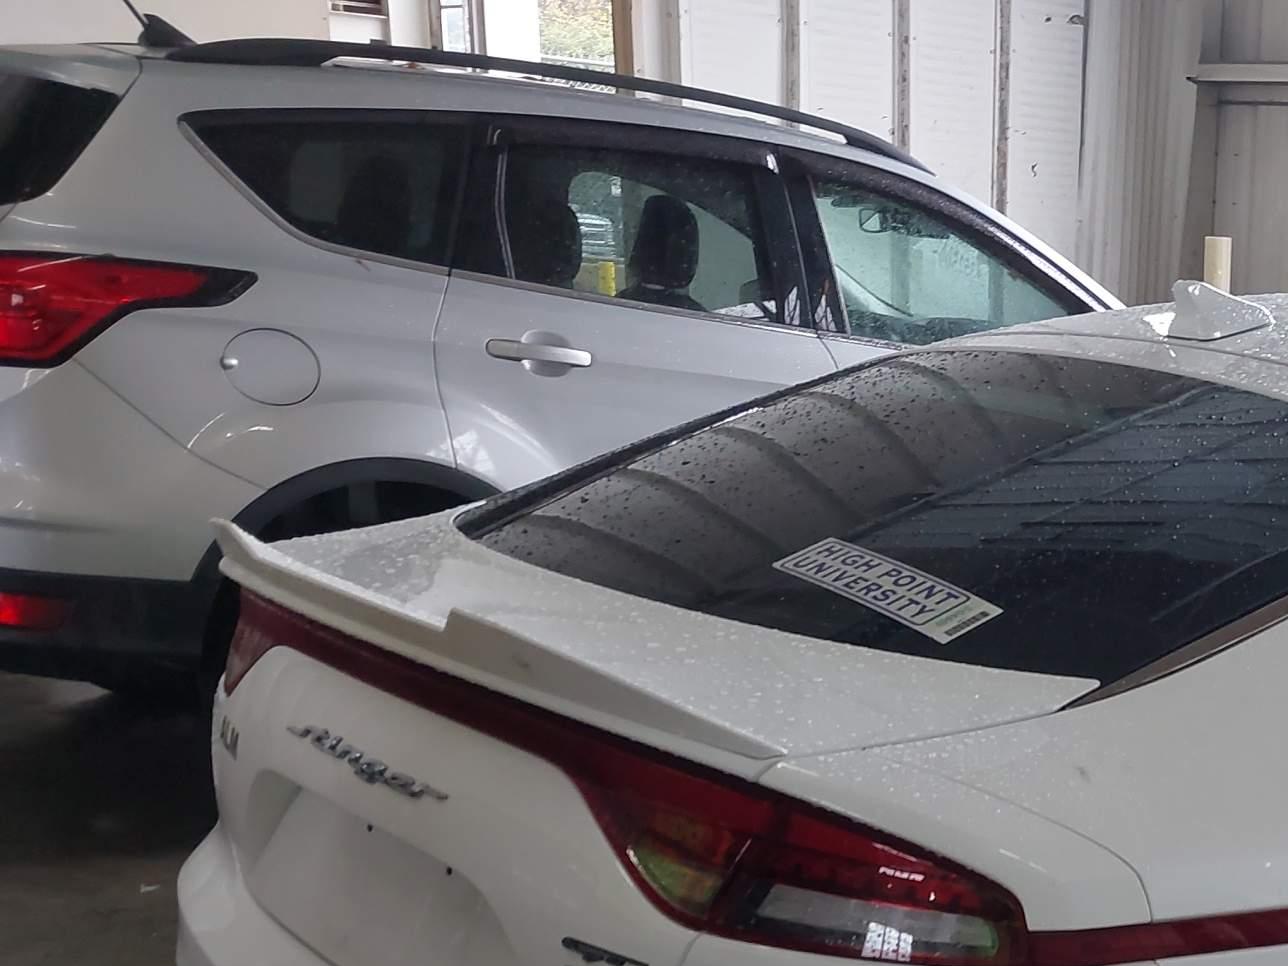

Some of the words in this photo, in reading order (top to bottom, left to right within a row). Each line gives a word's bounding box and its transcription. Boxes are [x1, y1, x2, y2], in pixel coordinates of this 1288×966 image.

[792, 555, 936, 619] UNIVERSITY
[815, 545, 882, 573] HIGH
[879, 567, 960, 606] POINT
